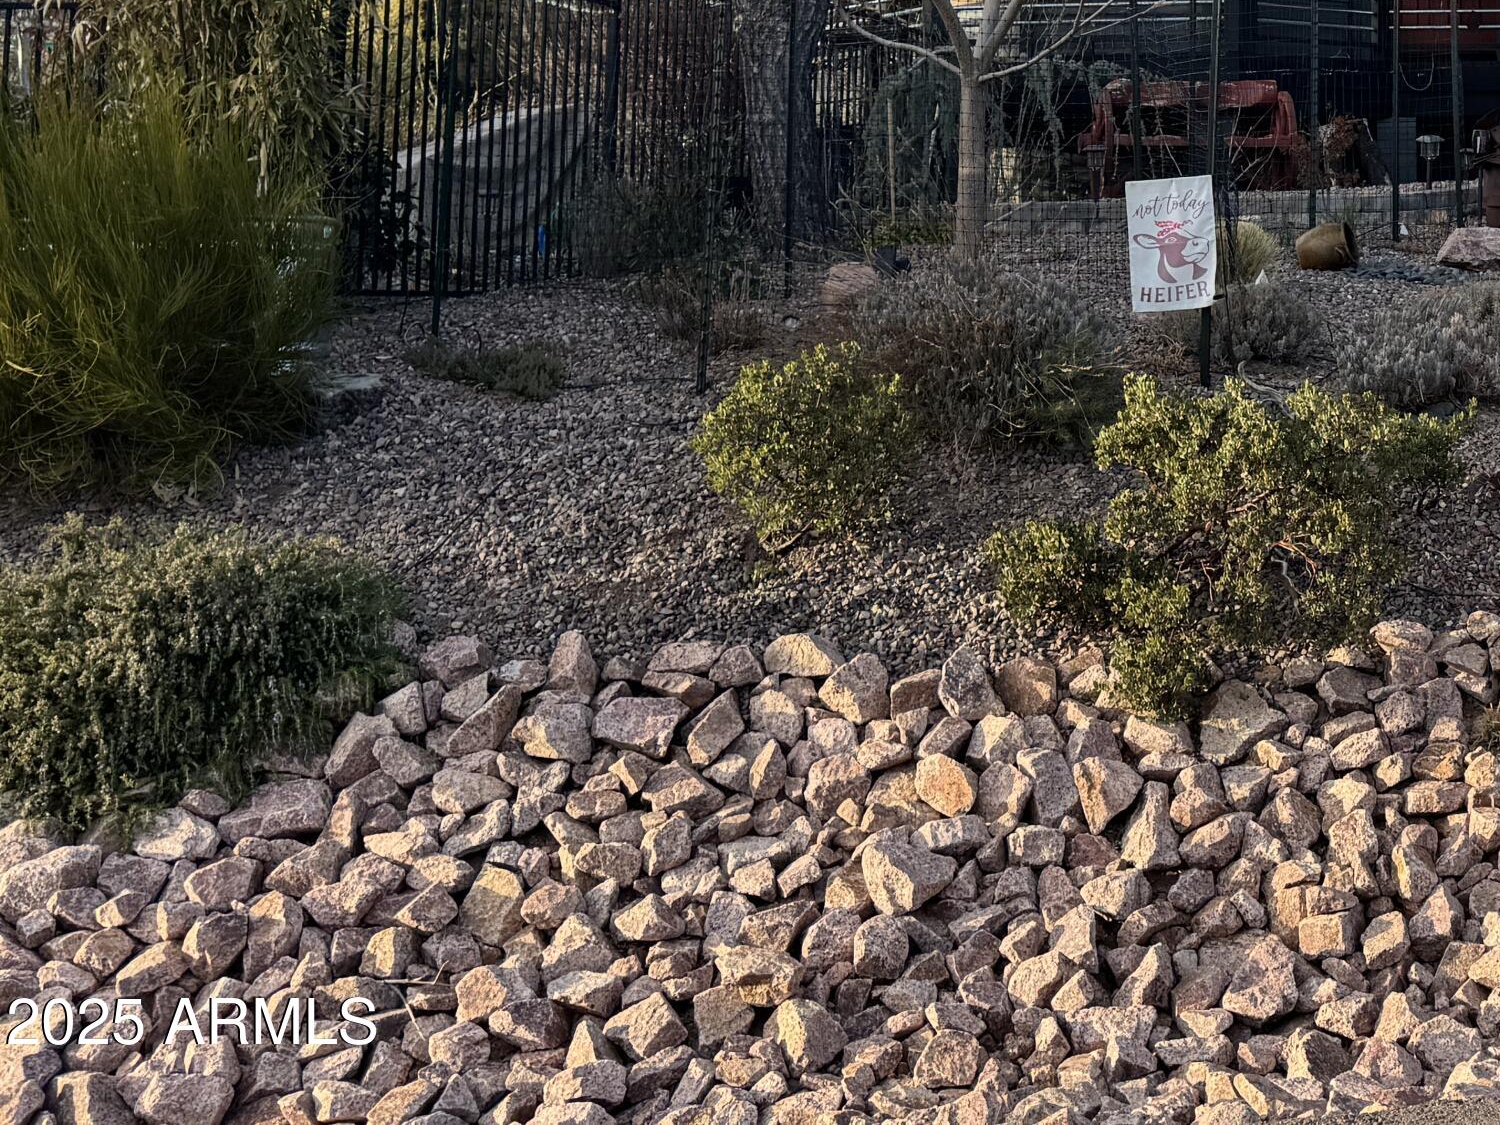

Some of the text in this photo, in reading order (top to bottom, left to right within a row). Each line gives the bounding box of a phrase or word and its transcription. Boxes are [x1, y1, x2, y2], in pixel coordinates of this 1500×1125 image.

[1132, 189, 1210, 219] not today
[1140, 280, 1211, 303] HEIFER
